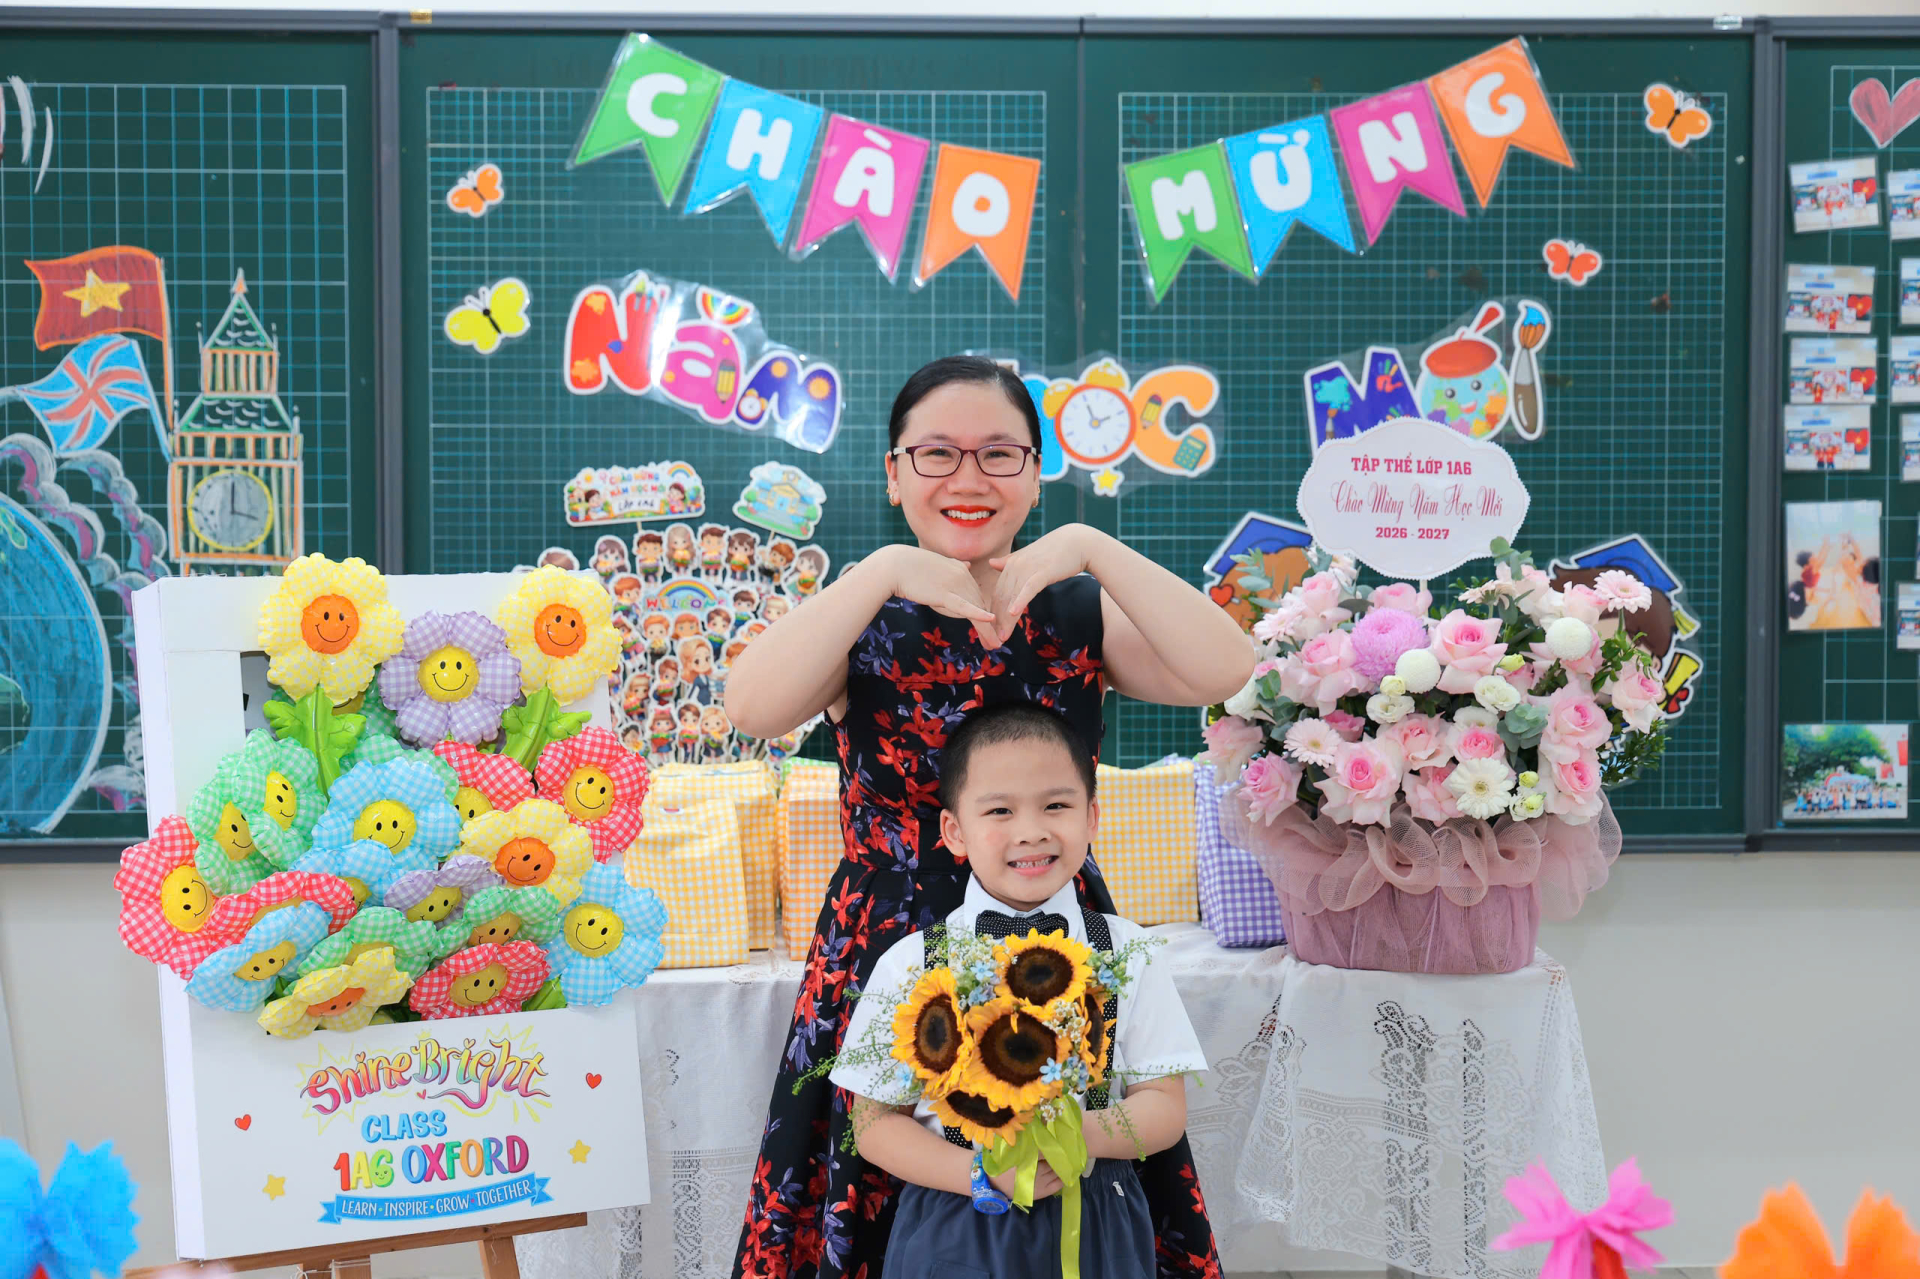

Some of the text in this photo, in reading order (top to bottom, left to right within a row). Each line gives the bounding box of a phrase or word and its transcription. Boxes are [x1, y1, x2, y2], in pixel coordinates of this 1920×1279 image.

[626, 71, 1527, 240] CHÀO MỪNG
[1351, 452, 1472, 476] TẬP THỂ LỚP 1A6
[1375, 527, 1408, 539] 2026
[1418, 528, 1450, 540] 2027
[300, 1037, 551, 1114] Shine Bright
[361, 1109, 447, 1143] CLASS
[333, 1135, 530, 1191] 1A6 OXFORD
[341, 1179, 532, 1217] LEARN INSPIRE GROW TOGETHER
